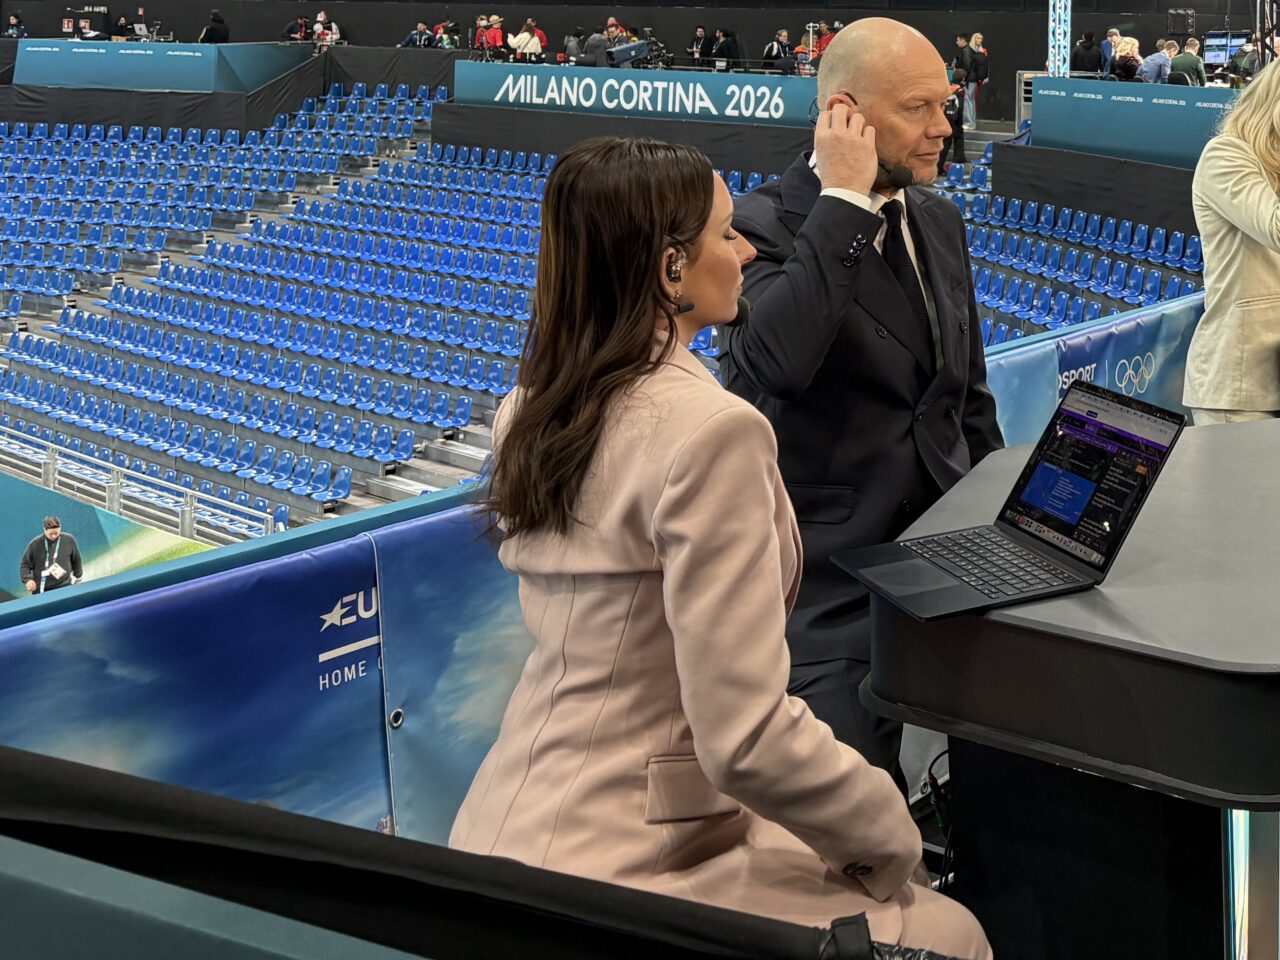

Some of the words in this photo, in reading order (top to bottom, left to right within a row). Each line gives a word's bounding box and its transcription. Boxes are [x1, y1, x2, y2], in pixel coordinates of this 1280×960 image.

[494, 74, 598, 109] MILANO
[601, 78, 719, 115] CORTINA
[724, 84, 785, 119] 2026
[319, 660, 368, 692] HOME
